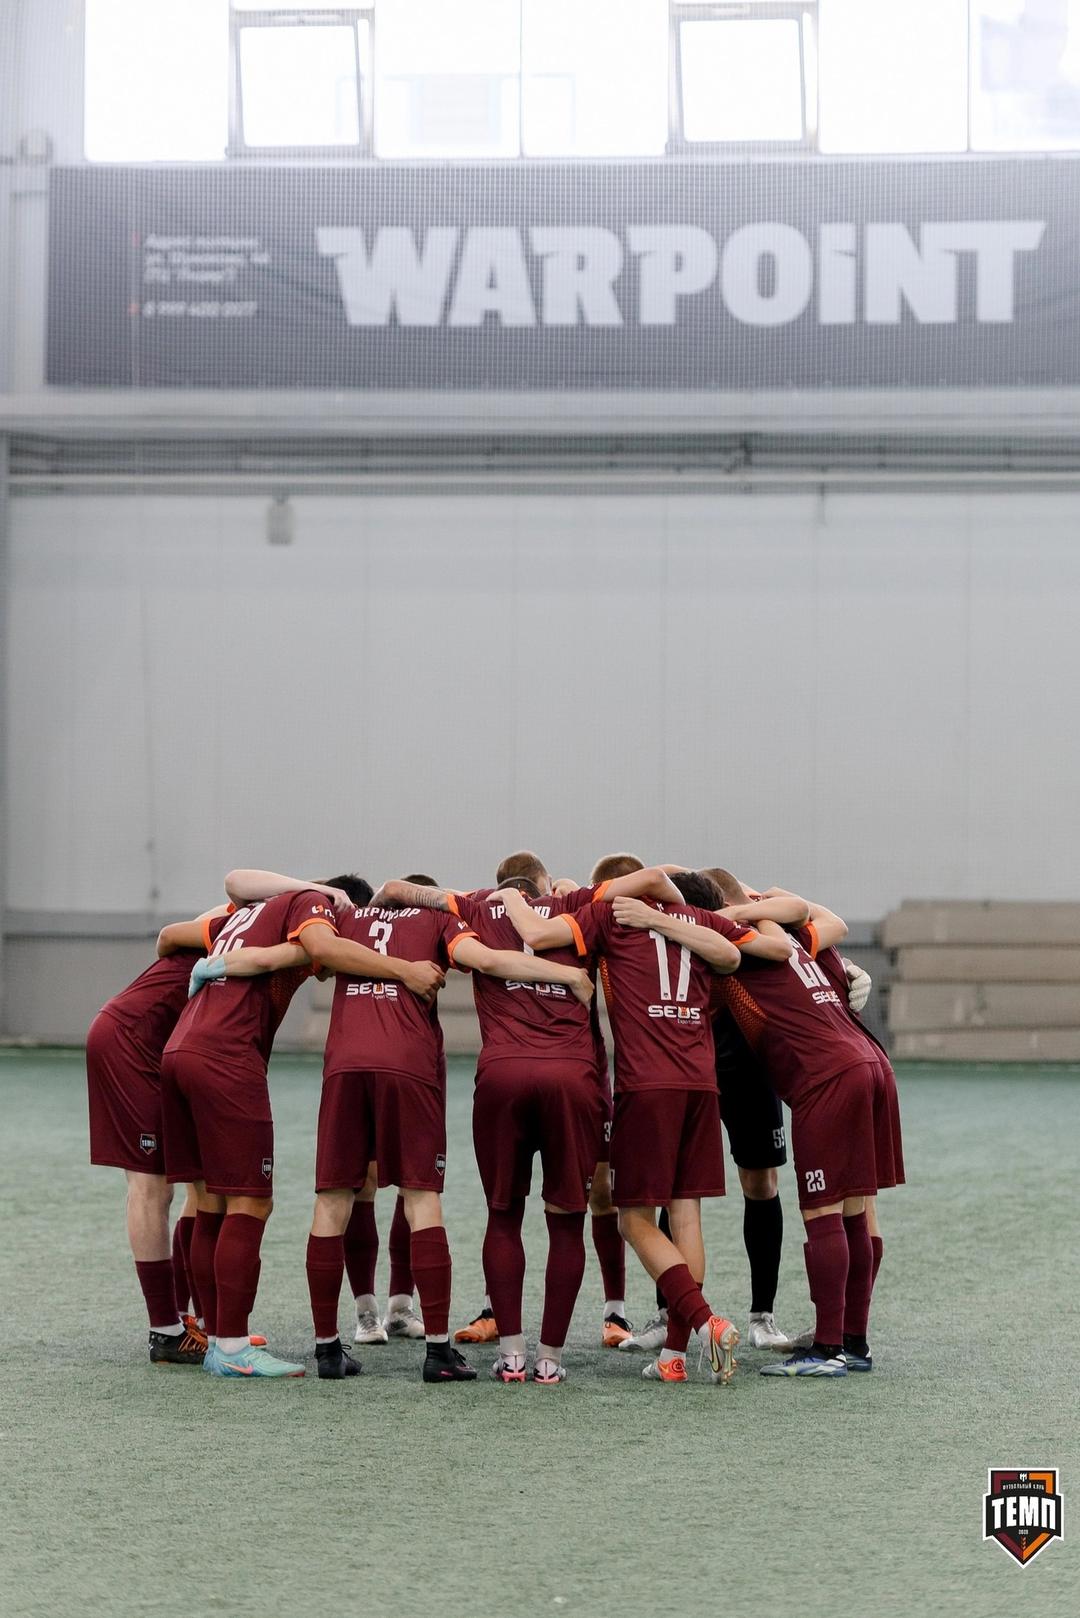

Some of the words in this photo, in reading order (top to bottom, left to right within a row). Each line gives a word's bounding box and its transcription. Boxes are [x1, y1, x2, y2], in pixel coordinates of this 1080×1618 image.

[368, 920, 393, 957] 3
[346, 982, 398, 997] SEUS
[648, 1004, 701, 1019] SEUS
[805, 1168, 827, 1193] 23
